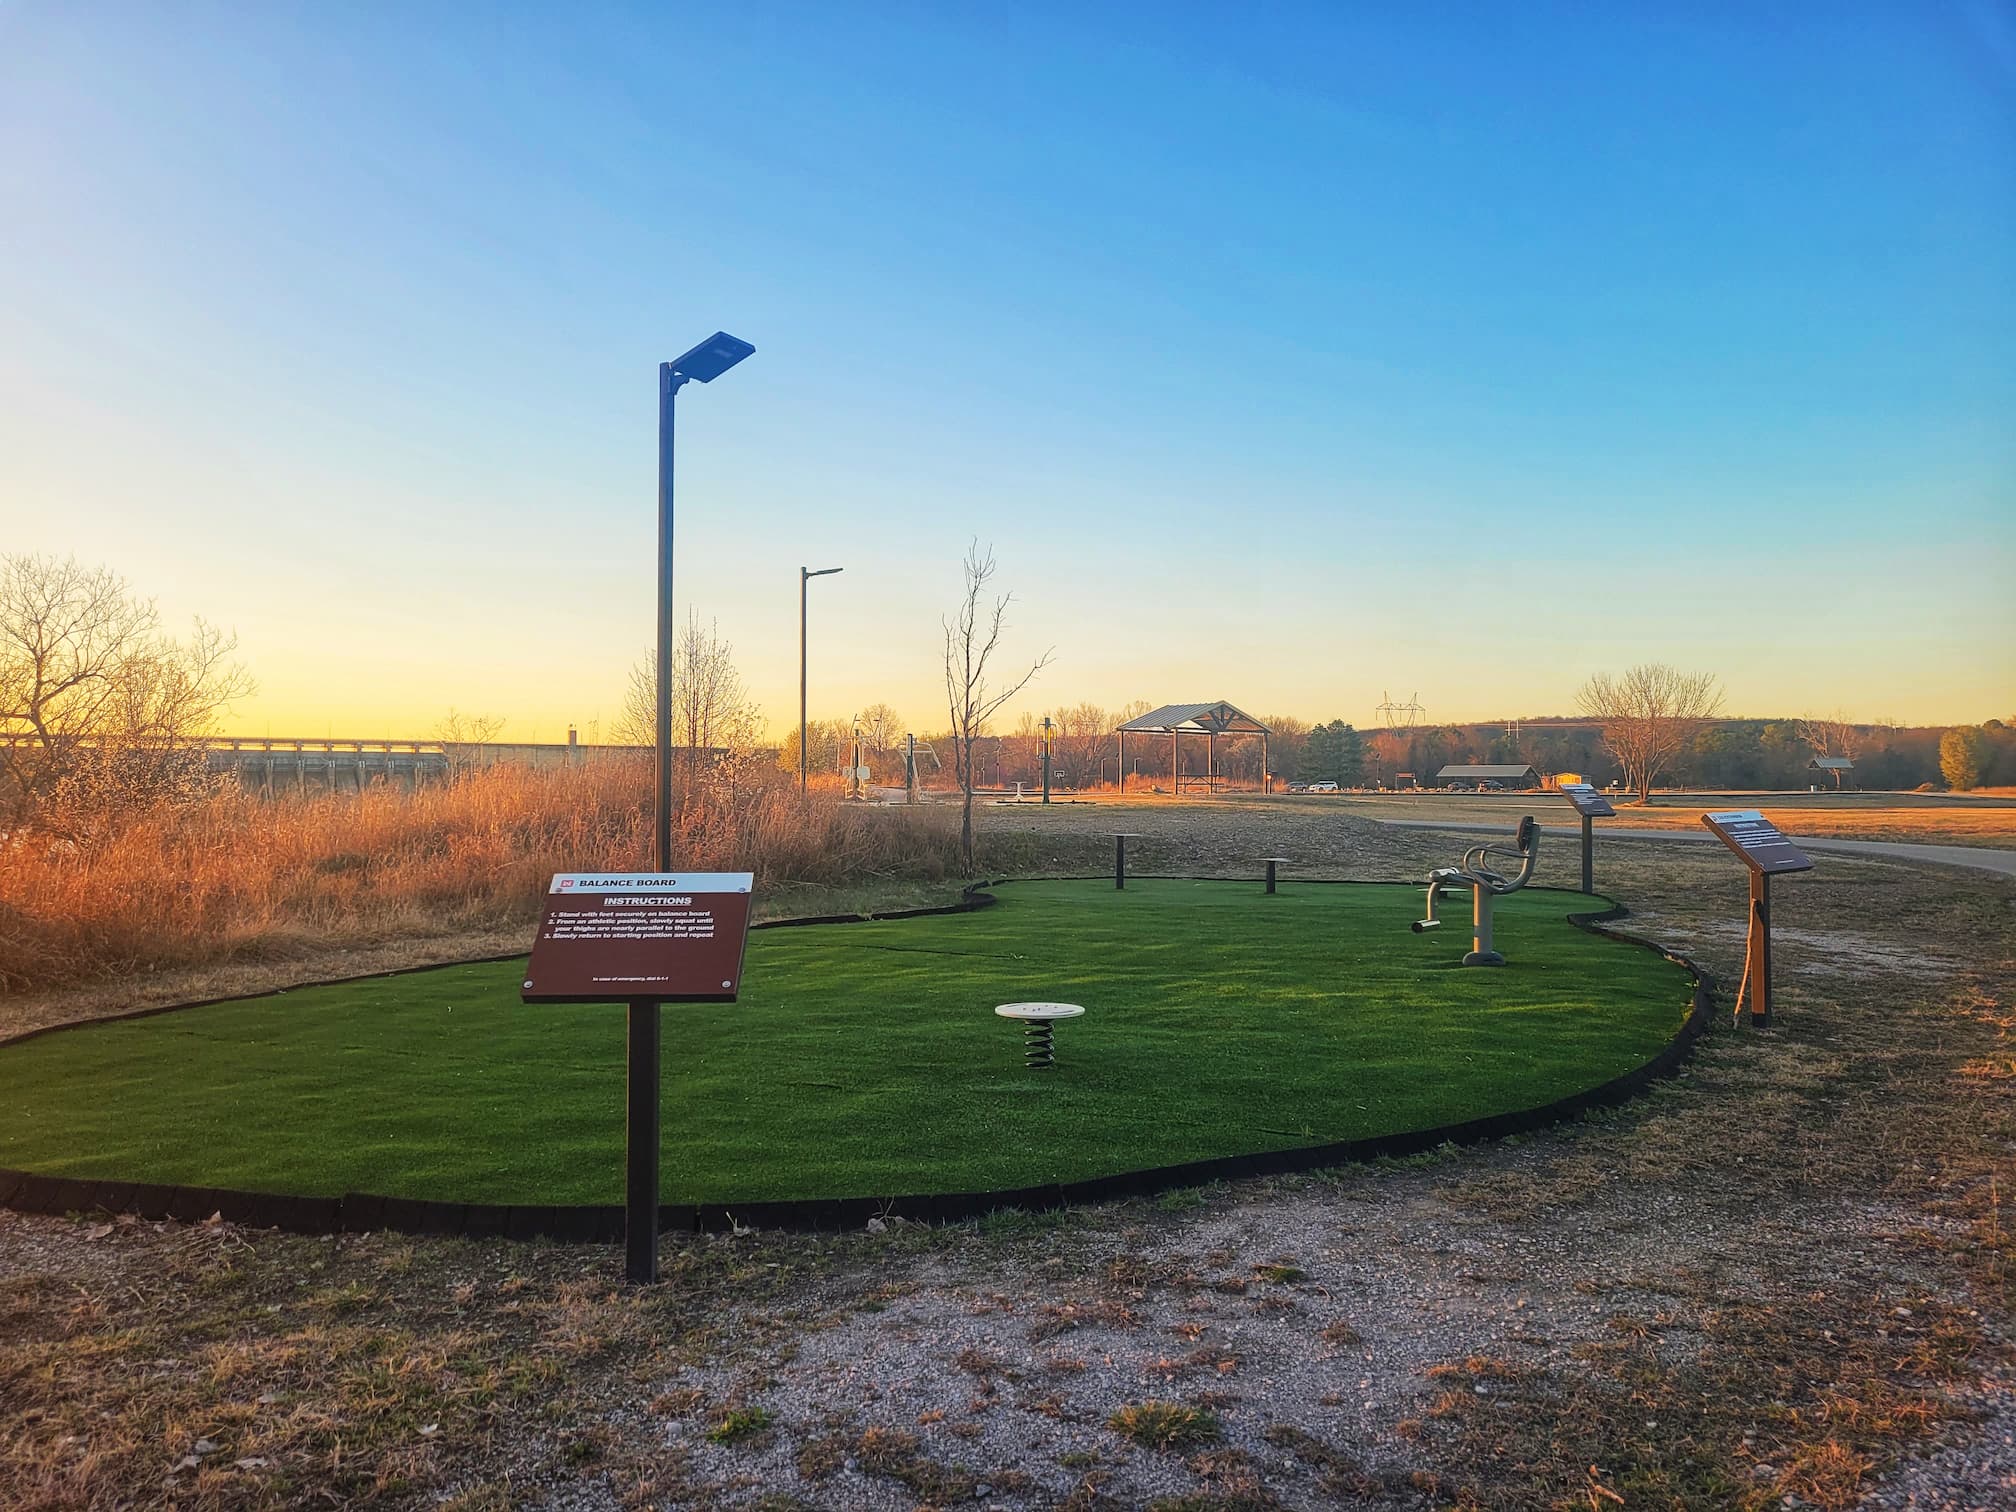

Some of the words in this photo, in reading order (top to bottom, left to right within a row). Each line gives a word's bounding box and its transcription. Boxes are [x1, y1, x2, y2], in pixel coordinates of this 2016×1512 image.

[579, 879, 633, 887] BALANCE
[636, 879, 677, 887] BOARD
[603, 896, 692, 906] INSTRUCTIONS
[573, 925, 596, 933] thighs
[687, 924, 715, 932] ground
[612, 932, 642, 940] starting
